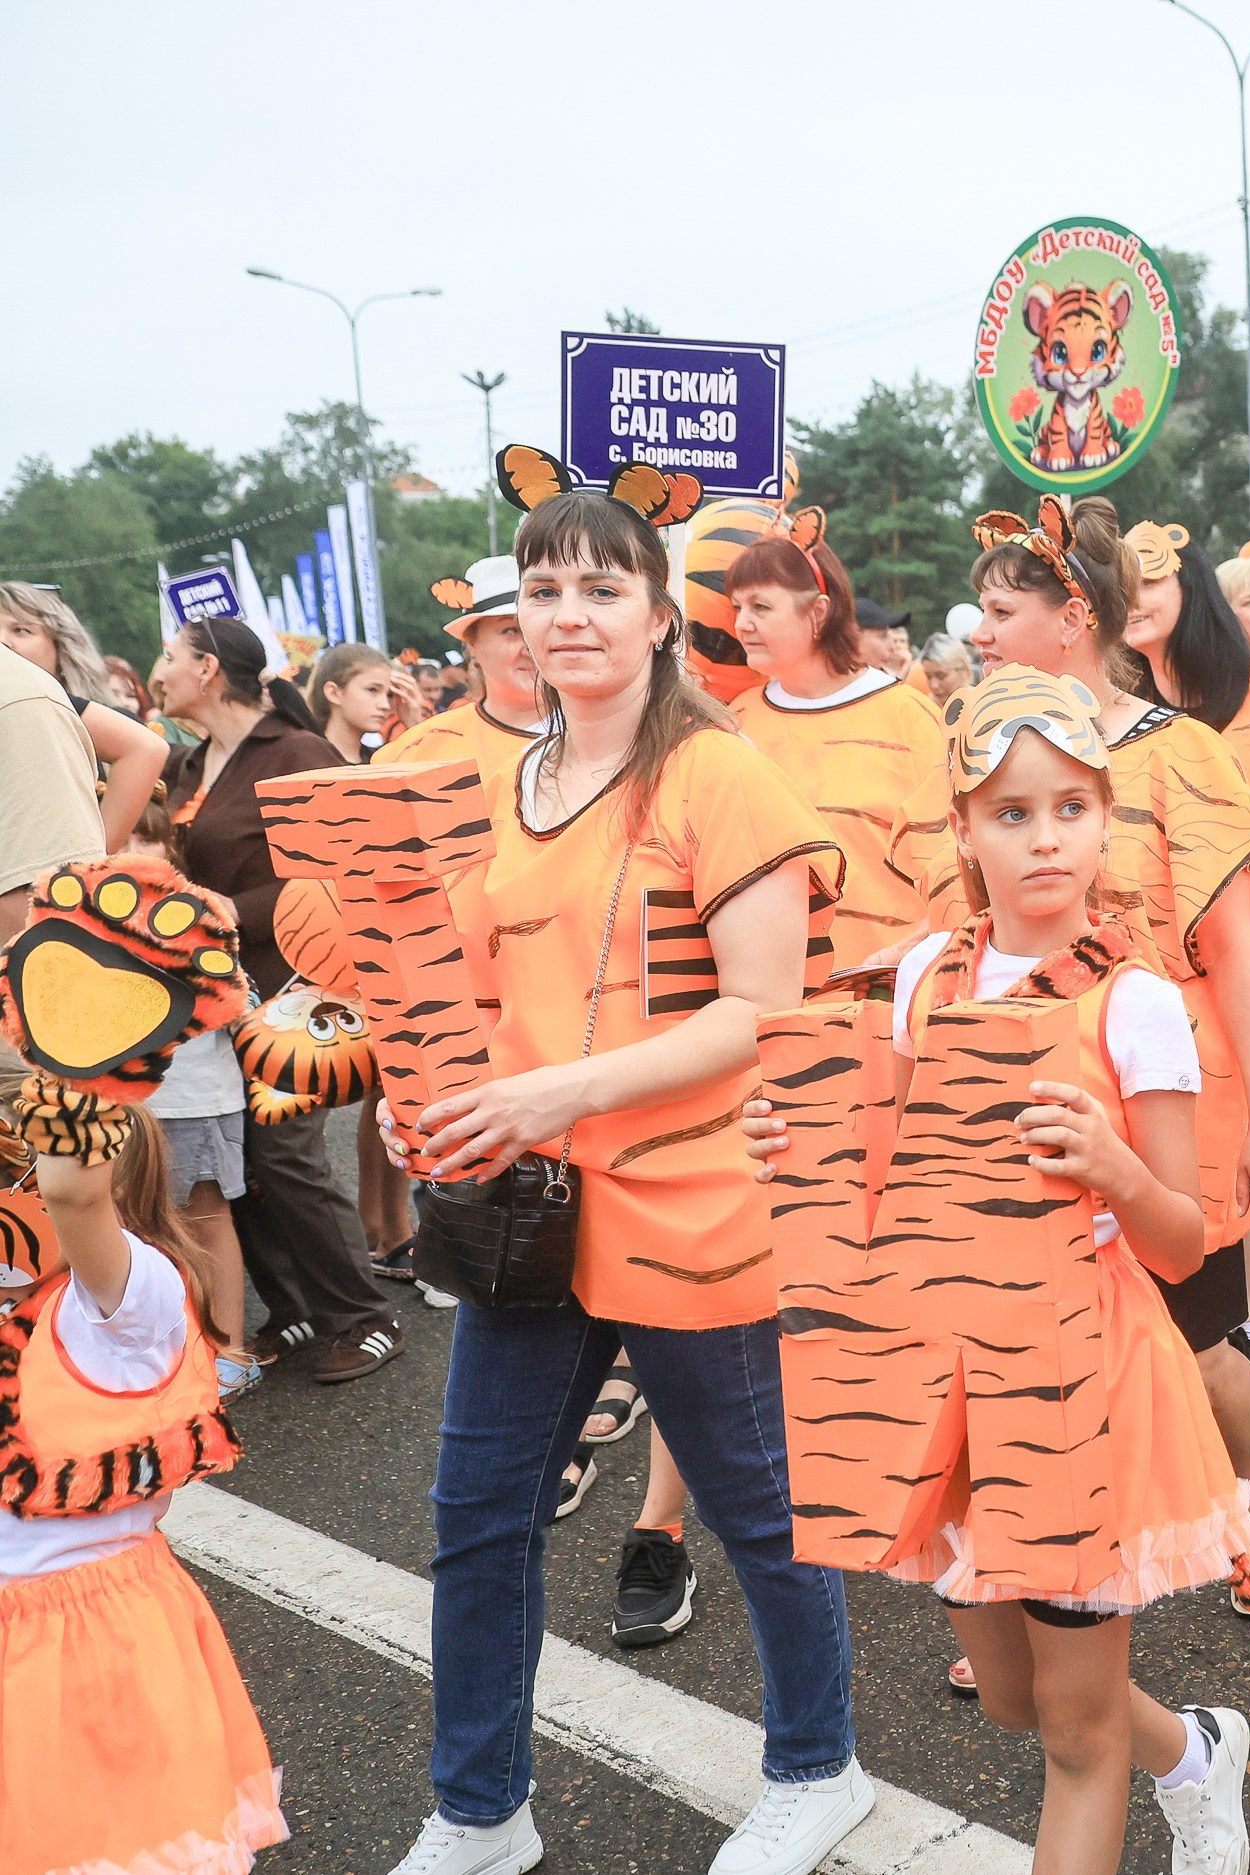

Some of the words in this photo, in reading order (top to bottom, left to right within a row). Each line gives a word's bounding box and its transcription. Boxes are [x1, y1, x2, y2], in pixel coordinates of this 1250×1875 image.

[978, 259, 1025, 375] МБДОУ
[1137, 262, 1166, 311] сад
[610, 366, 738, 406] ДЕТСКИЙ
[610, 404, 669, 444] САД
[676, 410, 737, 443] №30
[608, 444, 628, 463] с.
[632, 442, 738, 470] Борисовка
[177, 578, 225, 607] ДЕТСКИЙ
